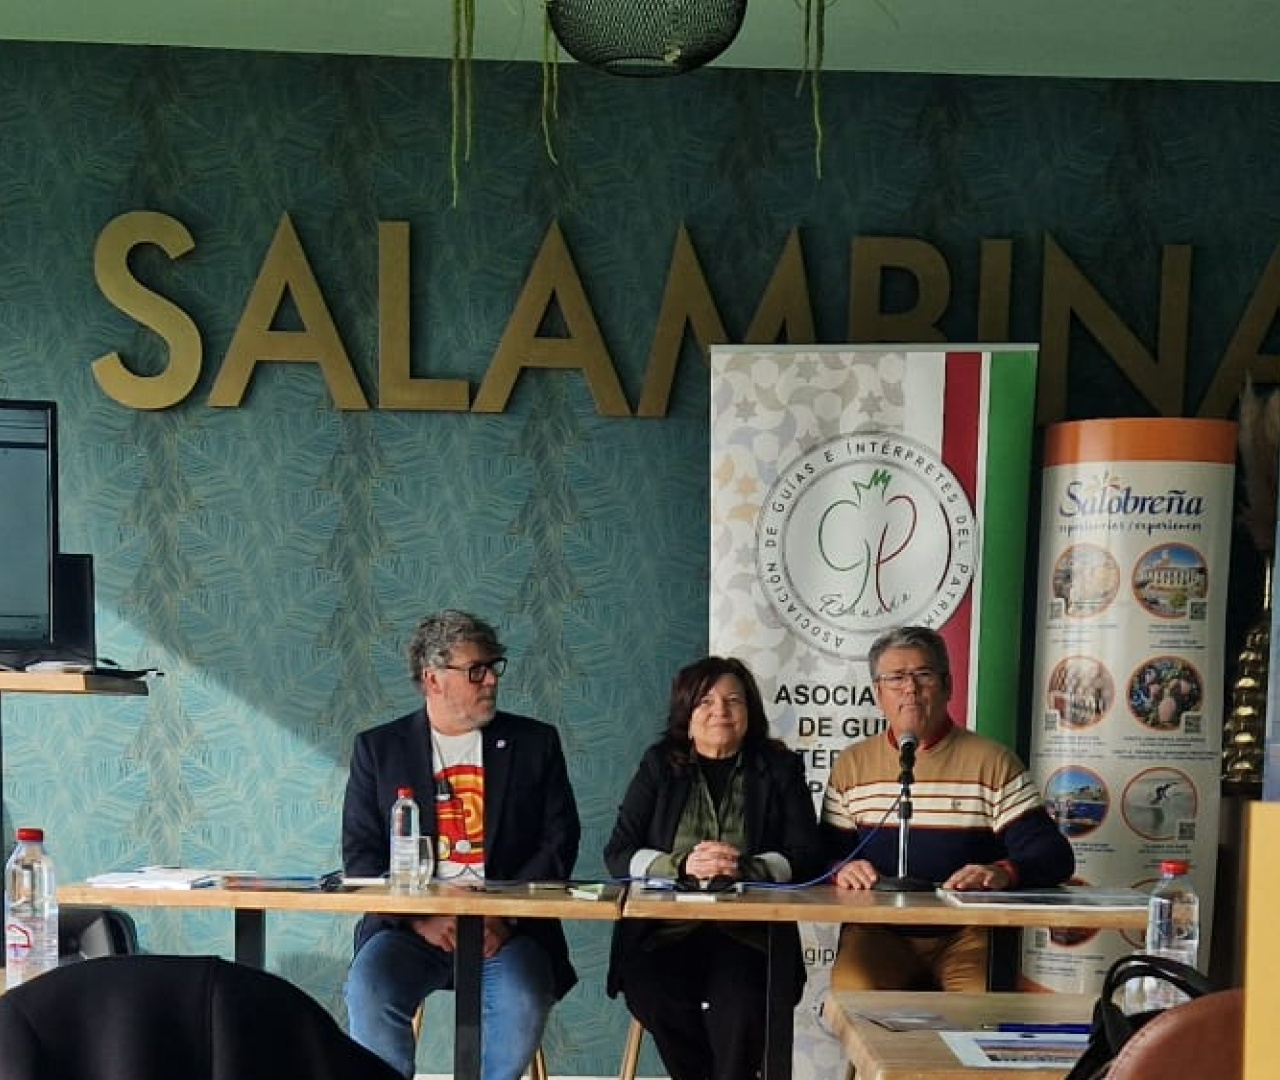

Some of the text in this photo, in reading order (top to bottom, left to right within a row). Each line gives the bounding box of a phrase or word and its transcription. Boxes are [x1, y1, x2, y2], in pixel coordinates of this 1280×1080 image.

[1059, 481, 1205, 517] Salobreña
[764, 526, 779, 549] DE
[955, 514, 970, 549] DEL
[799, 716, 833, 737] DE
